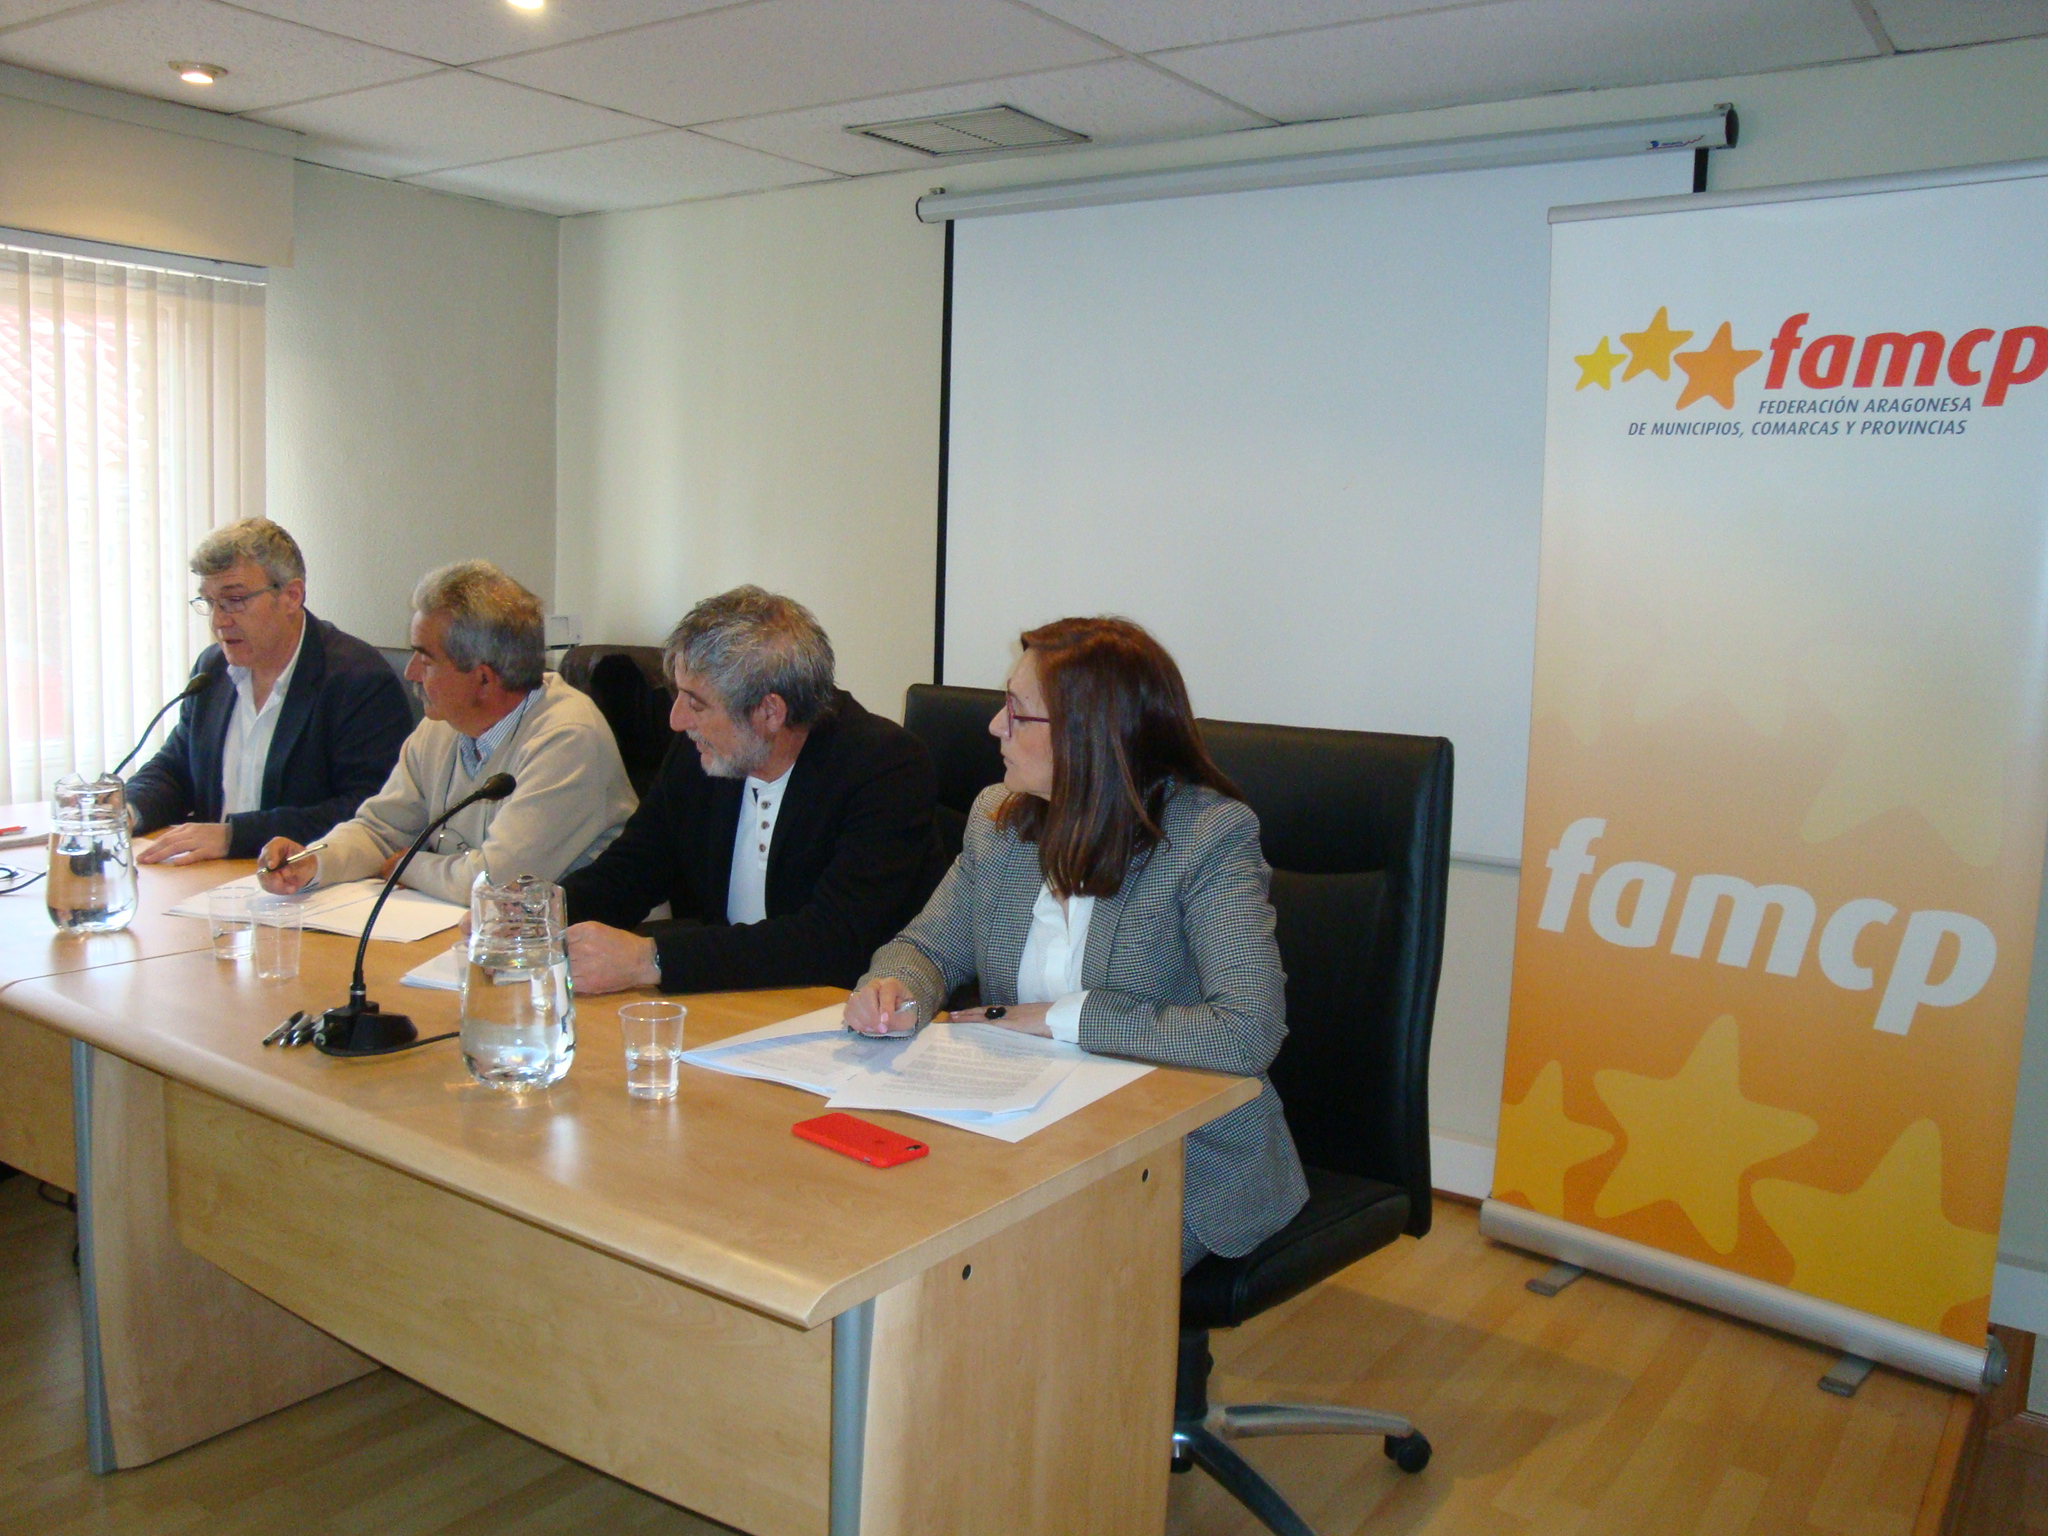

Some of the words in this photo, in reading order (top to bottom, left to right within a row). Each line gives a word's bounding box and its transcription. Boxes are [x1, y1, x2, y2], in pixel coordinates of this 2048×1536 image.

[1764, 312, 2048, 407] famcp
[1628, 423, 1647, 436] DE
[1651, 421, 1745, 438] MUNICIPIOS,
[1751, 421, 1839, 436] COMARCAS
[1845, 420, 1856, 435] Y
[1860, 419, 1966, 435] PROVINCIAS
[1758, 396, 1858, 415] FEDERACIÓN
[1863, 397, 1971, 413] ARAGONESA
[1537, 817, 1997, 1036] famcp
